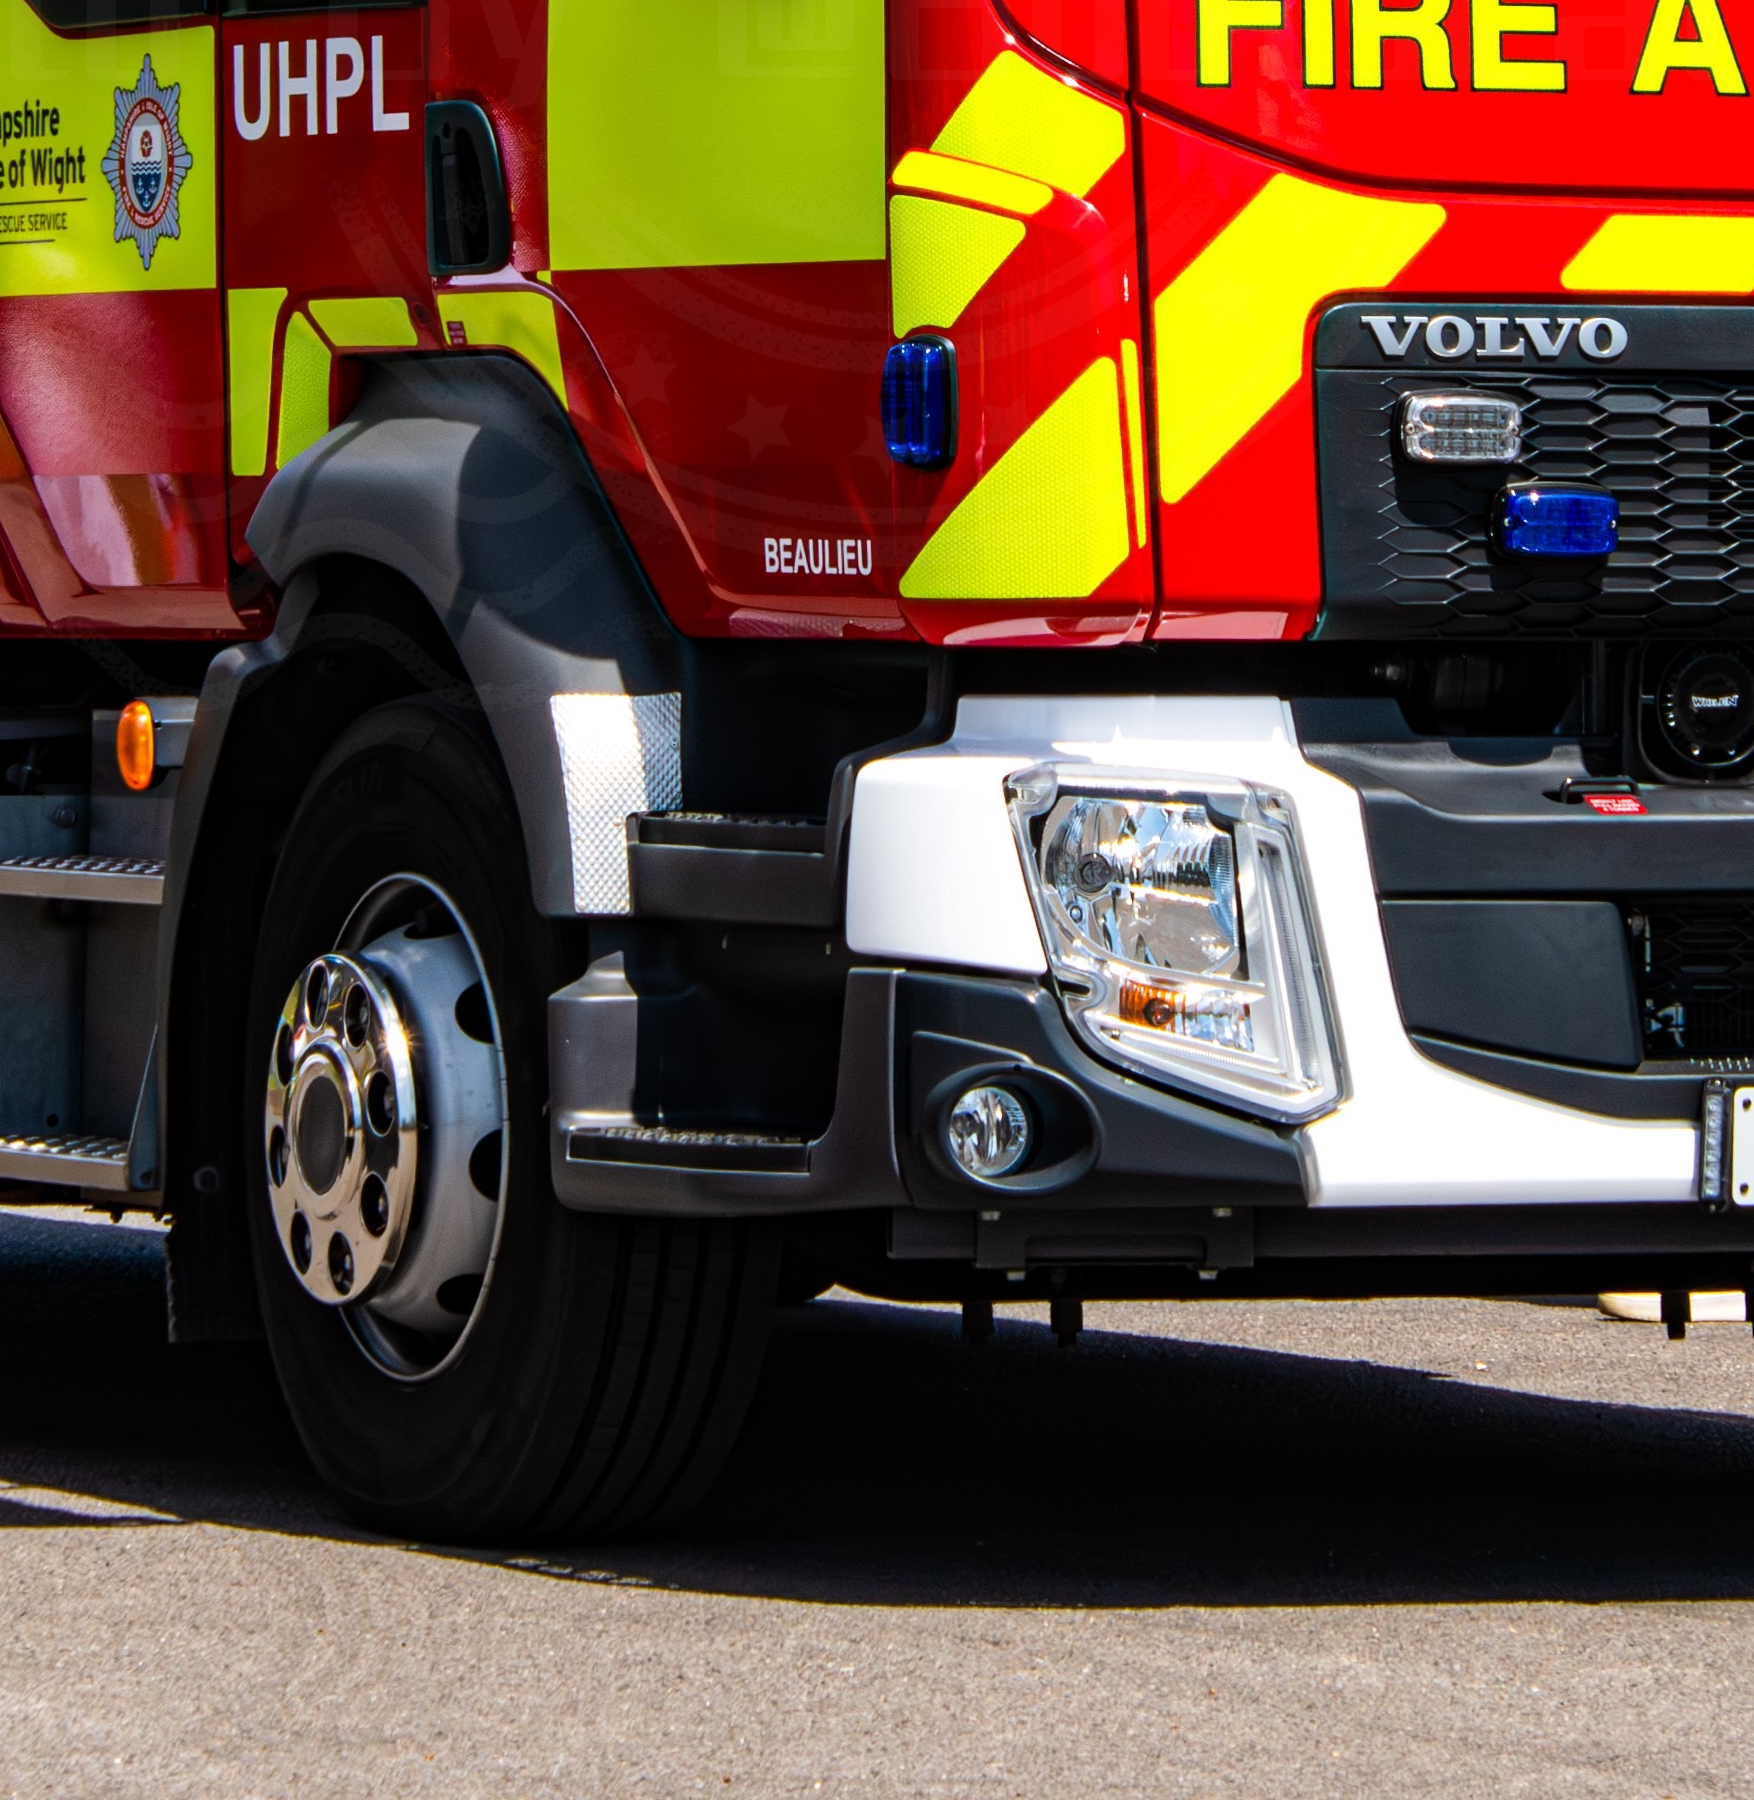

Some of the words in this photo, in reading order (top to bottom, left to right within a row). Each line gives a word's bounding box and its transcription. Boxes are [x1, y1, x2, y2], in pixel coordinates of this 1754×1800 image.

[232, 35, 410, 141] UHPL
[8, 148, 26, 189] of
[31, 145, 86, 194] Wight
[28, 212, 68, 232] SERVICE
[1361, 315, 1628, 360] VOLVO
[764, 538, 873, 576] BEAULIEU
